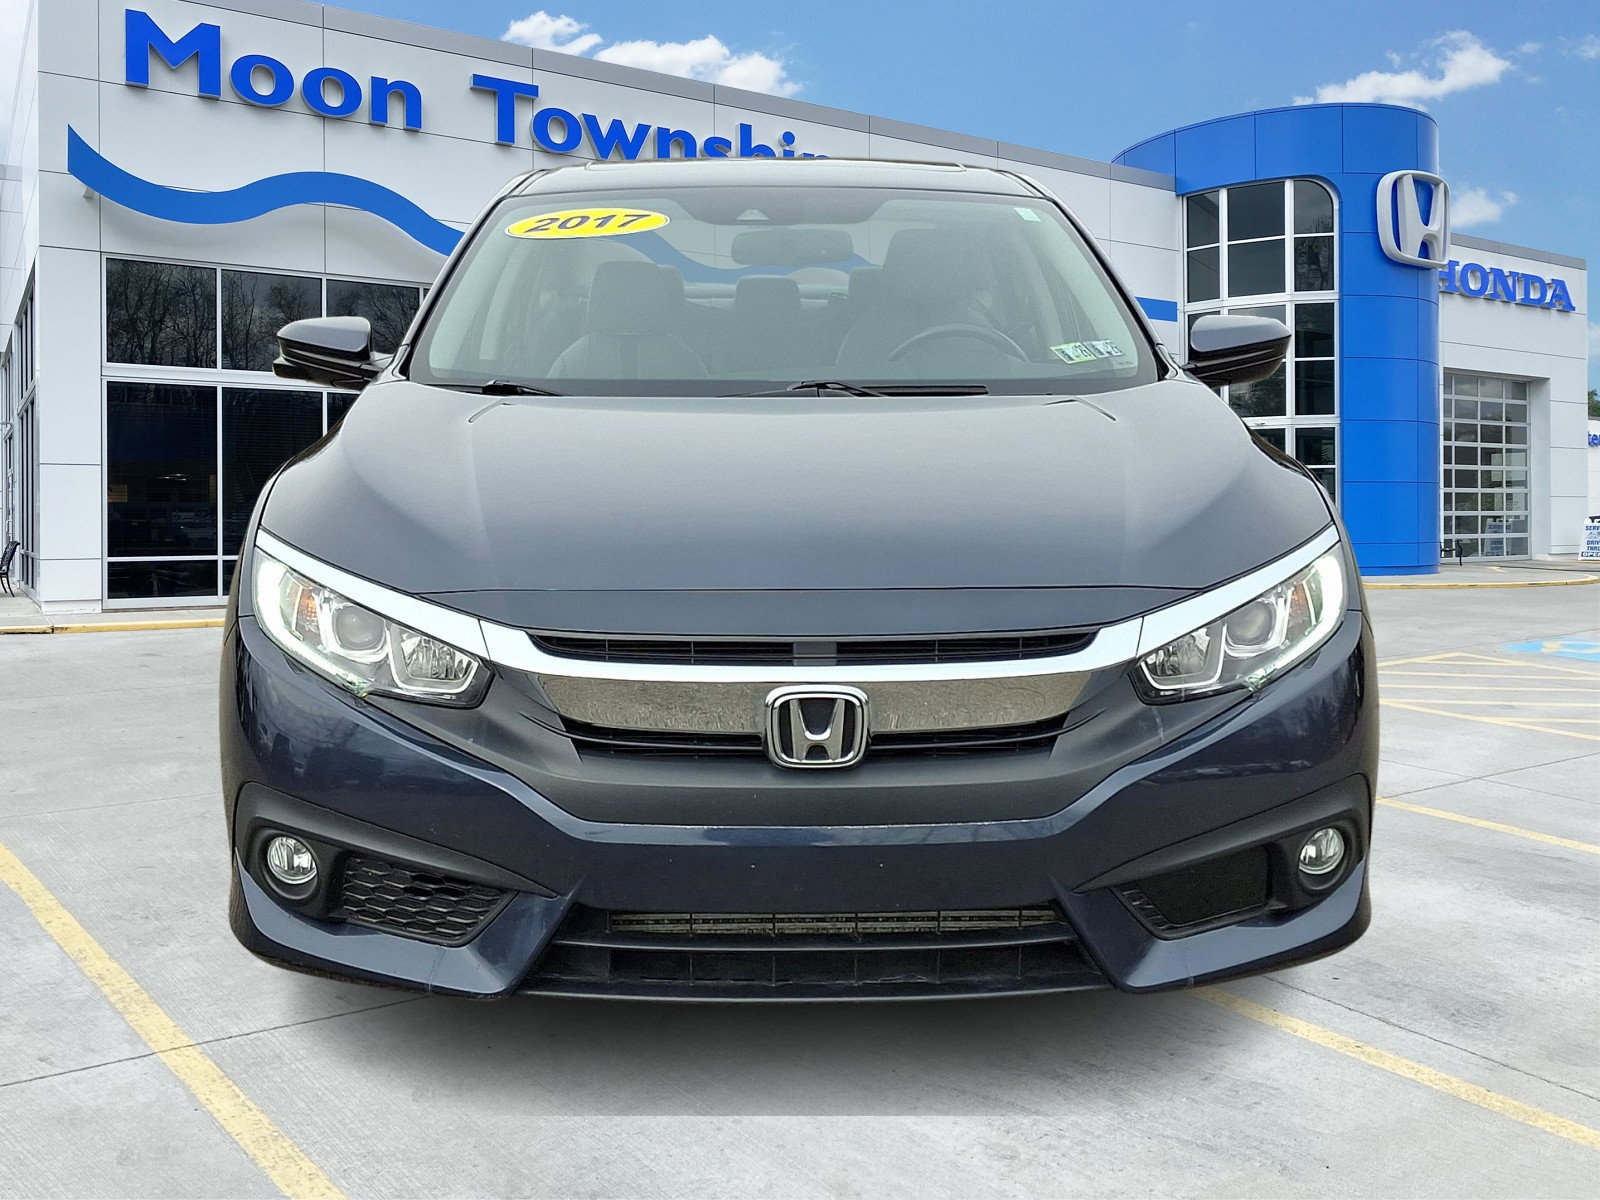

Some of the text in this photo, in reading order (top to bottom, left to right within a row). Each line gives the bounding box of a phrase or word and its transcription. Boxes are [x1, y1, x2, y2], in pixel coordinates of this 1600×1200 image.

[125, 8, 831, 159] Moon Townshi
[523, 214, 651, 233] 2017
